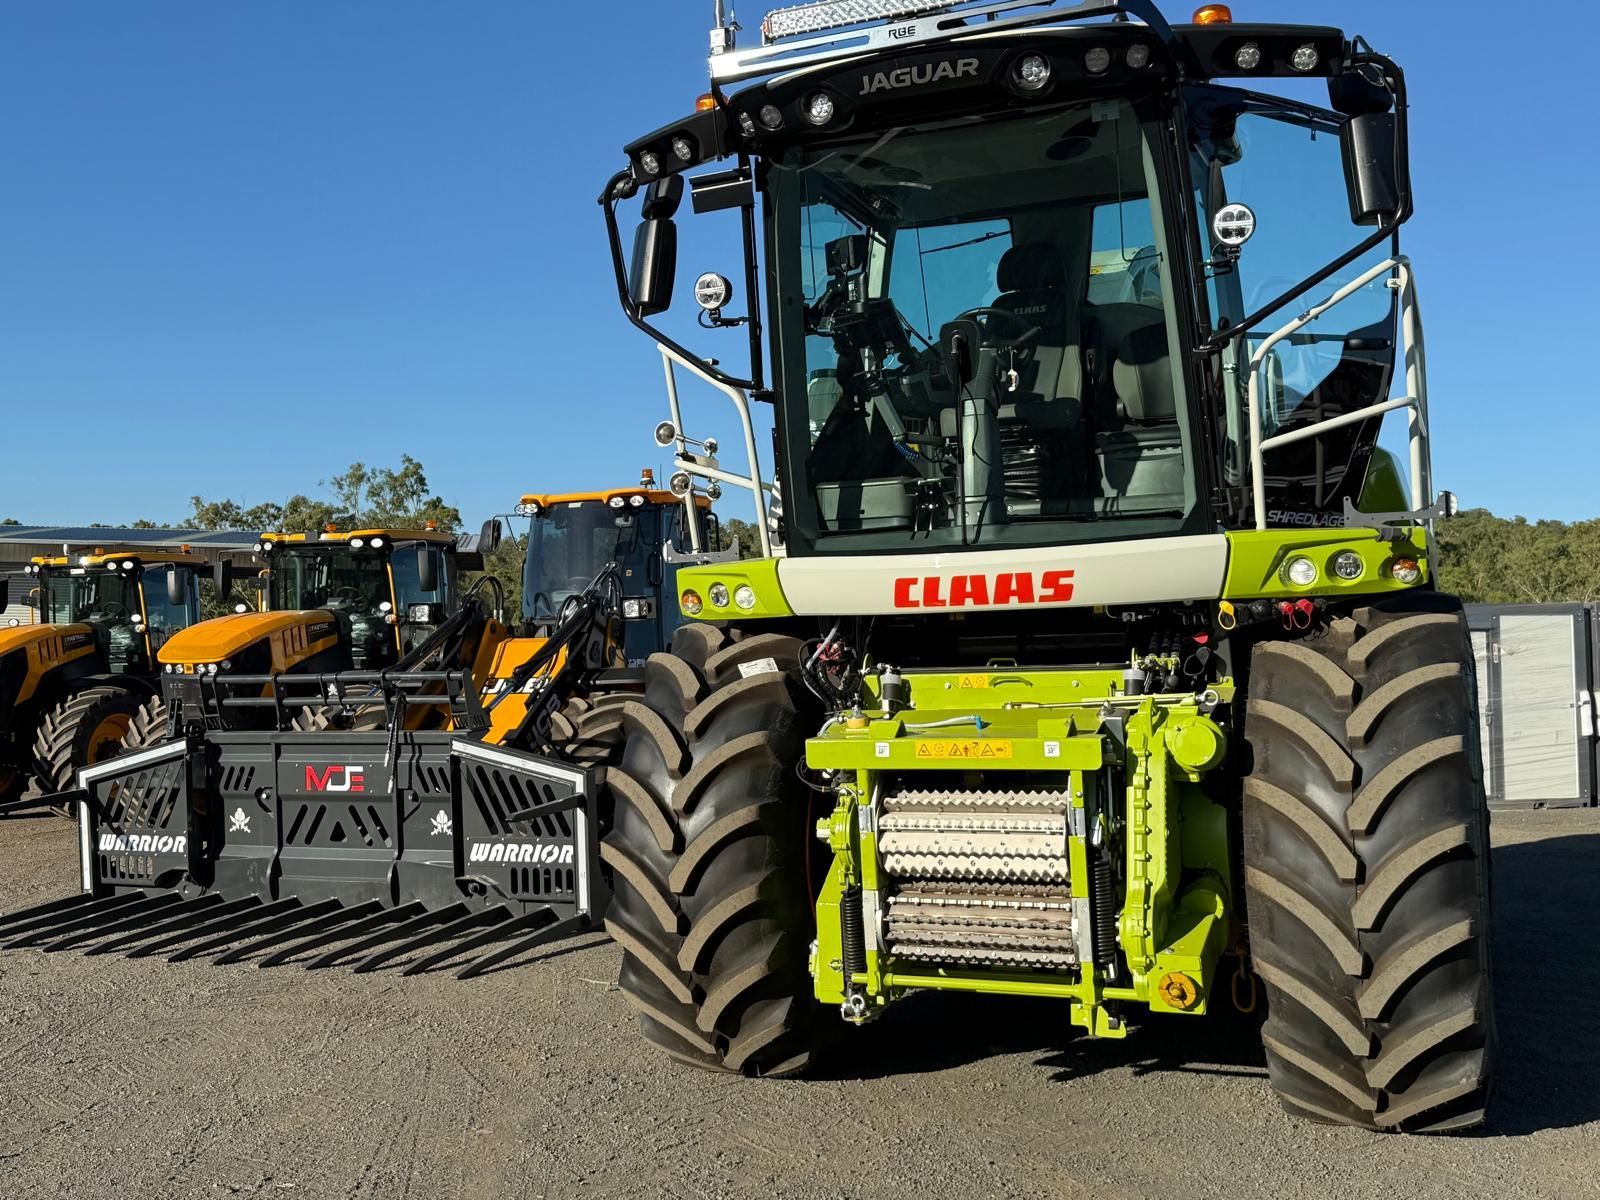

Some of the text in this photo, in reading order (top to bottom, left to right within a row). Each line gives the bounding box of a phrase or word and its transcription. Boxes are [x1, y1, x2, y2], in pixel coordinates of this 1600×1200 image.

[888, 25, 916, 39] RBE
[859, 58, 980, 95] JAGUAR
[1014, 304, 1047, 315] CLAAS
[894, 570, 1075, 608] CLAAS
[99, 833, 187, 853] WARRIOR
[470, 843, 574, 864] WARRIOR
